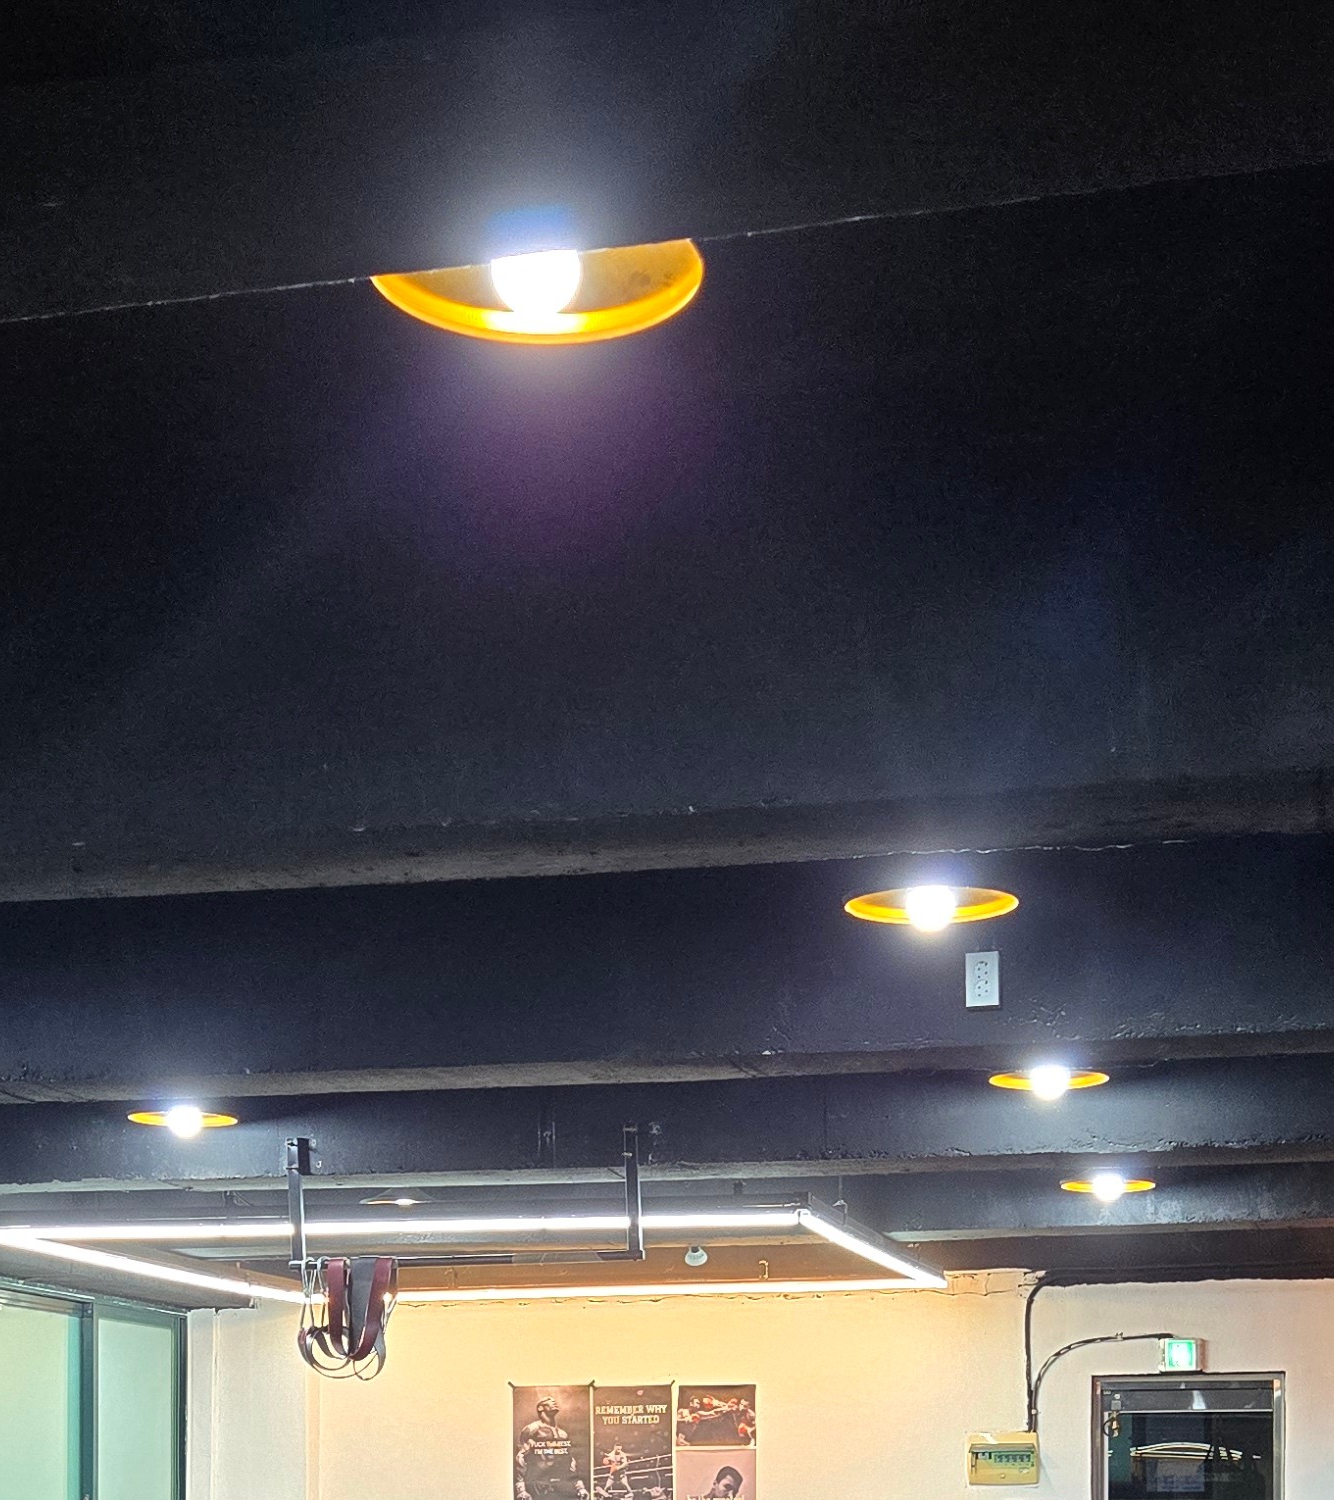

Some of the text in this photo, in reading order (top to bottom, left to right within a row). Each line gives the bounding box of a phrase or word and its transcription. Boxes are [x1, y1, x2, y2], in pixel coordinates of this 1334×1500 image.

[595, 1404, 667, 1415] REMEMBER WHY
[602, 1415, 660, 1425] YOU STARTED
